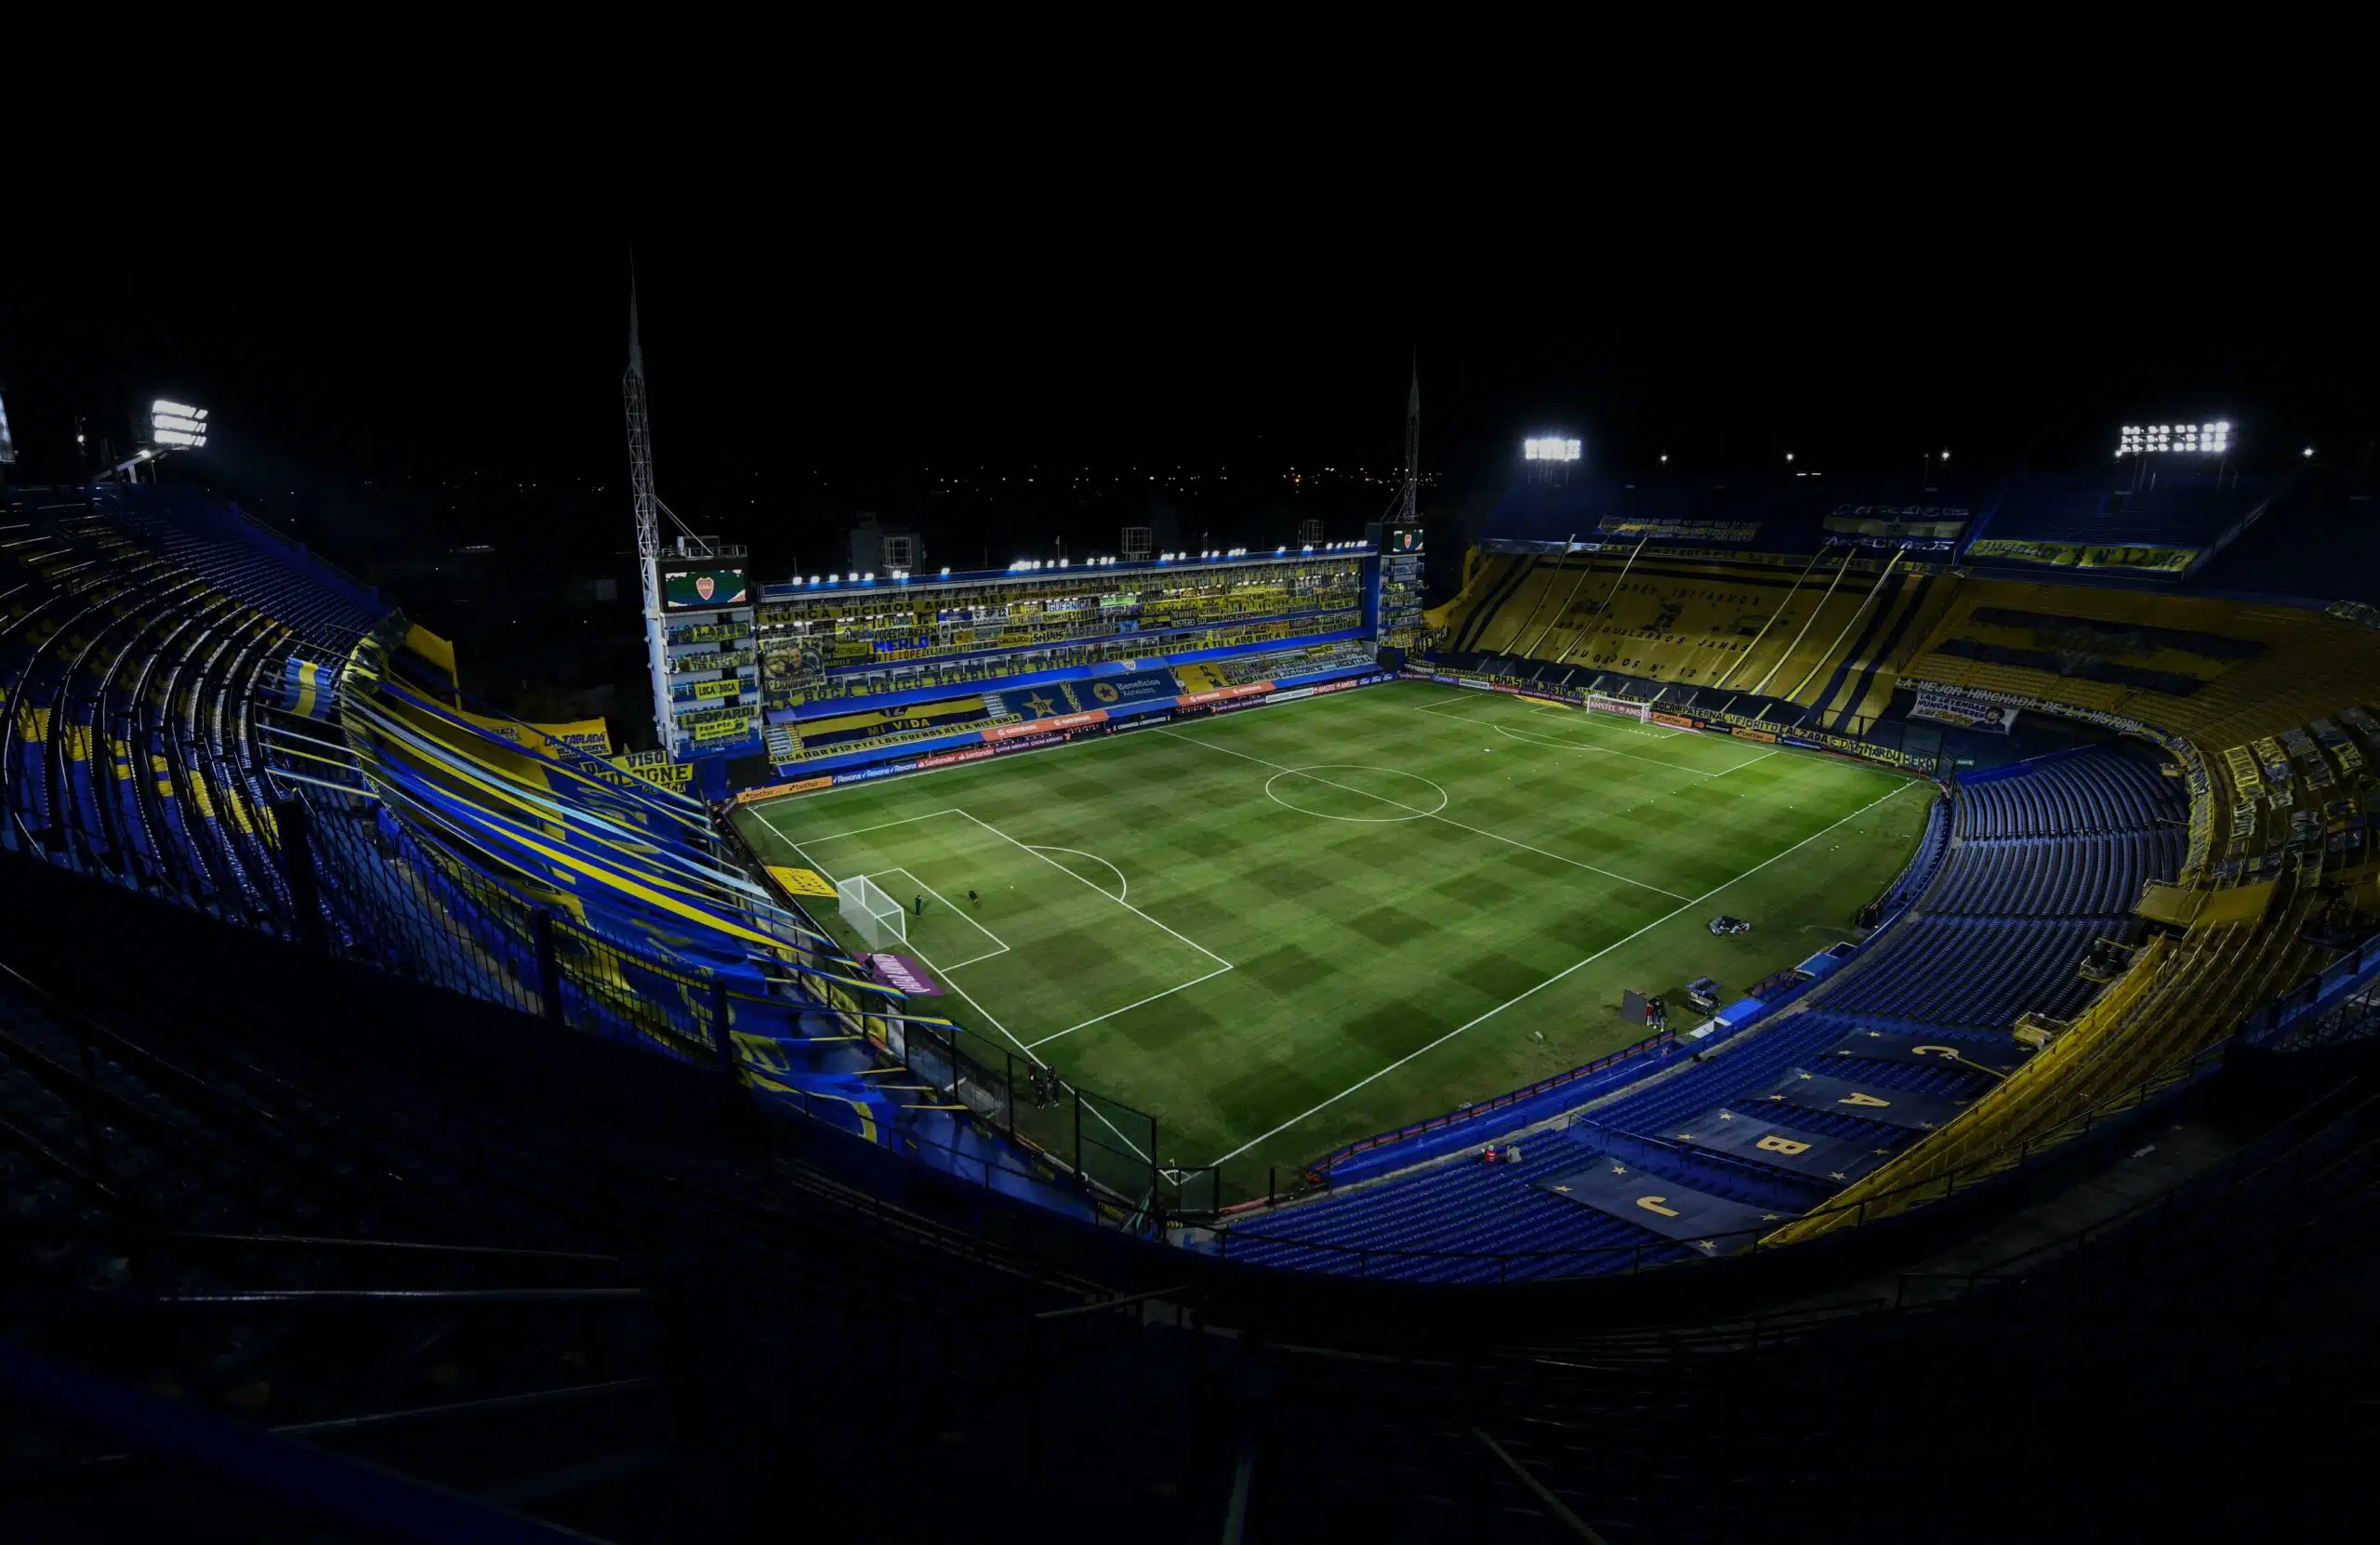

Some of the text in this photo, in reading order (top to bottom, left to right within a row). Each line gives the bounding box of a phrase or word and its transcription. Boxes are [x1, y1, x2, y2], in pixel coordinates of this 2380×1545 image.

[767, 608, 831, 623] NUNCA
[842, 601, 914, 618] HICIMOS
[925, 594, 1007, 610] AMISTADES
[1050, 601, 1090, 613] GUERNICA
[1117, 678, 1161, 692] Beneficios
[1917, 681, 1964, 696] MEJOR
[1966, 688, 2038, 708] HINCHADA
[1034, 701, 1049, 712] 70
[1590, 702, 1615, 711] AMSTEL
[1917, 700, 1950, 711] NUNCA
[1920, 693, 1987, 713] LAS LEYENDAS
[1625, 708, 1652, 719] AMSEL
[892, 719, 931, 732] VIDA
[1779, 725, 1828, 744] CALZADA
[627, 752, 664, 768] VISO
[964, 748, 995, 760] Santander
[894, 762, 918, 772] Rexona
[924, 755, 956, 767] Santander
[838, 772, 862, 784] Rexona
[866, 768, 890, 778] Rexona
